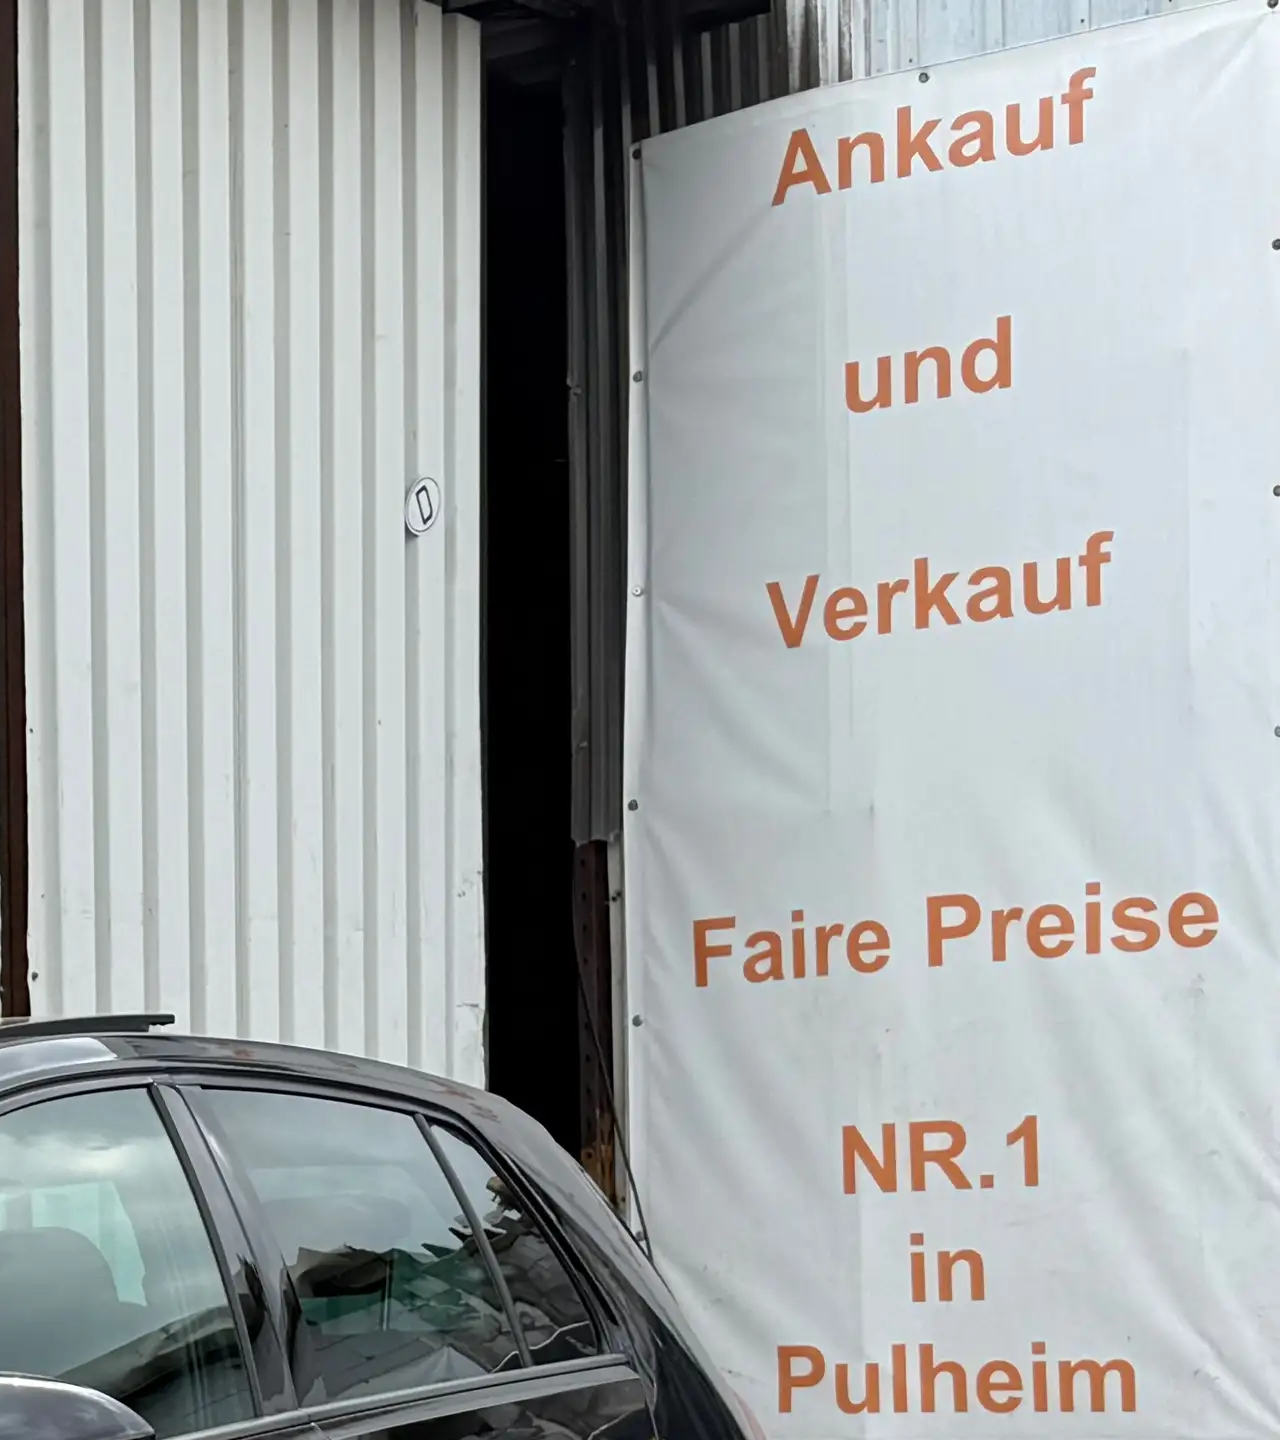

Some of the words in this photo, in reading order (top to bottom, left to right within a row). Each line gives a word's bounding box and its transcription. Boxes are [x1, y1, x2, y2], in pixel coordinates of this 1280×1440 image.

[773, 68, 1096, 206] Ankauf
[845, 315, 1012, 413] und
[766, 531, 1114, 648] Verkauf
[693, 910, 891, 988] Faire
[926, 882, 1219, 968] Preise
[841, 1115, 1039, 1195] NR.1
[910, 1233, 986, 1303] in
[777, 1342, 1137, 1415] Pulheim
